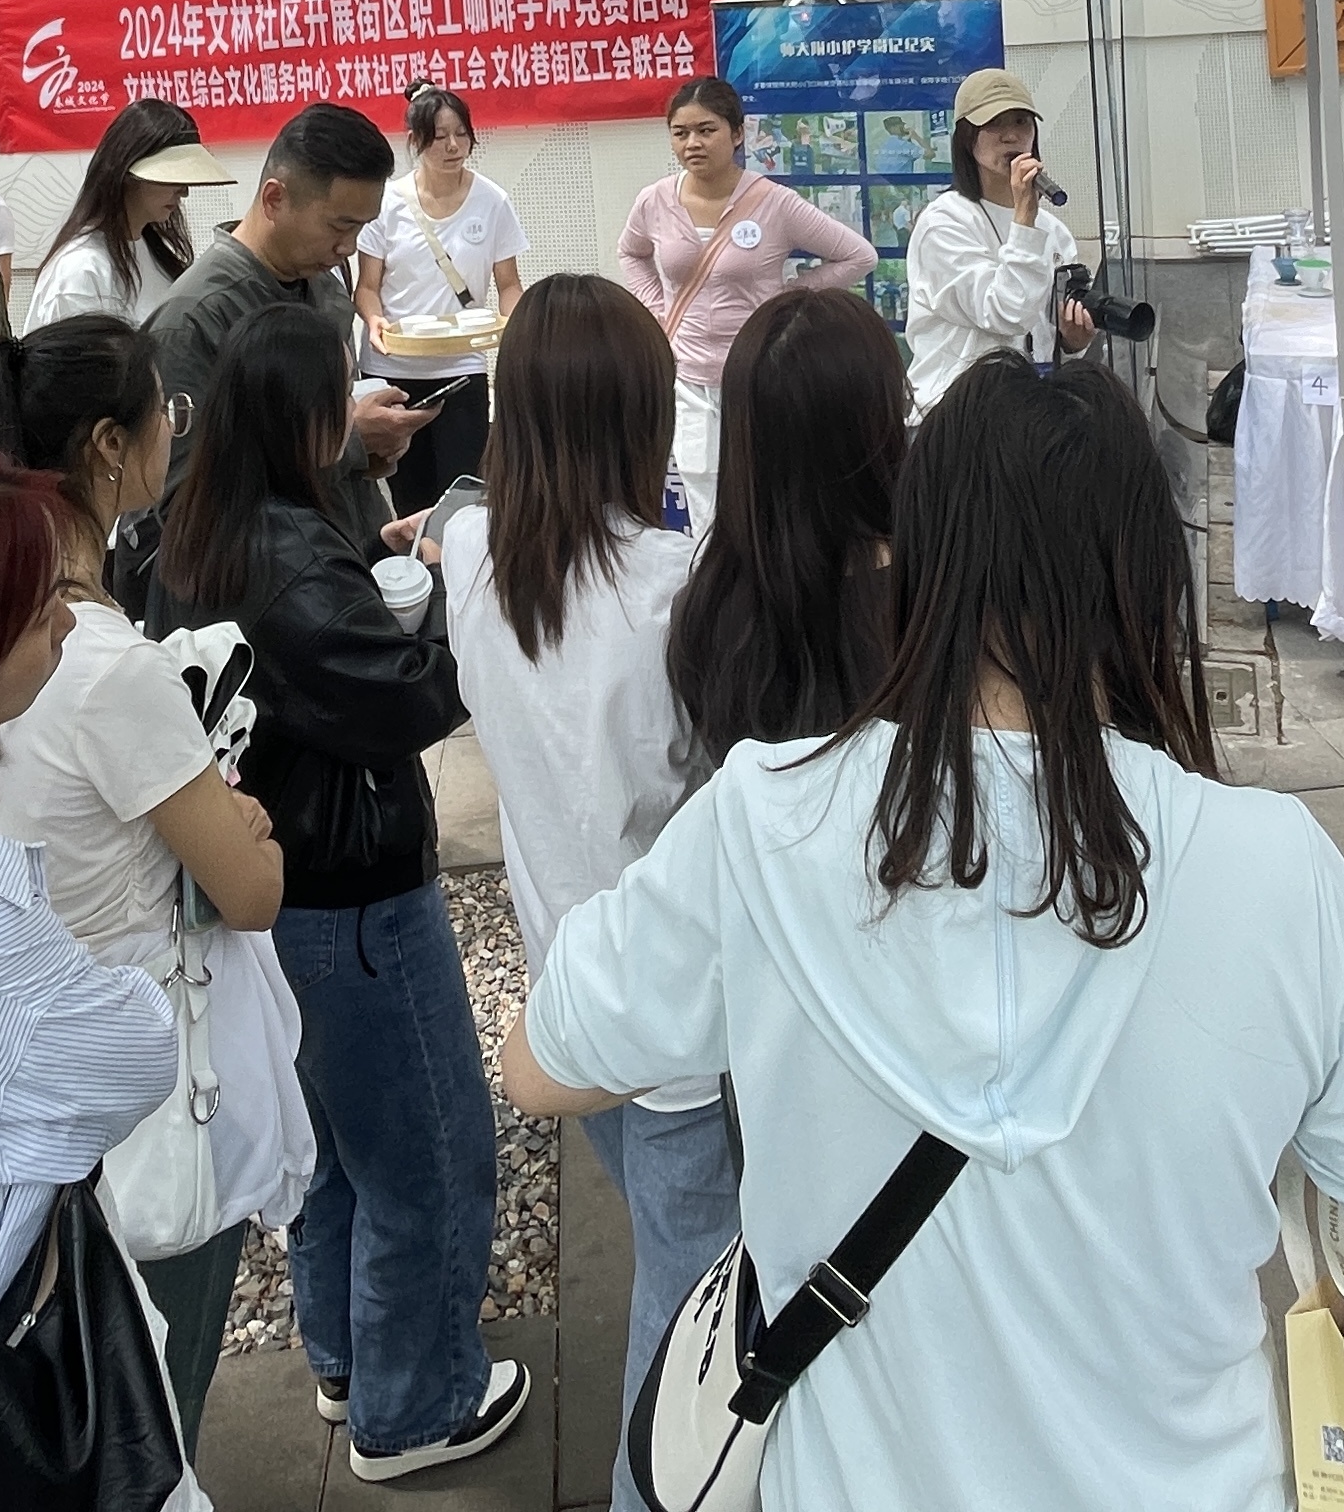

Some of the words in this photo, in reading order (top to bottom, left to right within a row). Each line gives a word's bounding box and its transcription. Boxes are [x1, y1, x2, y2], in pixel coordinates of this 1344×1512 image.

[123, 58, 332, 109] 文林社区综合文化服务中心
[490, 30, 695, 89] 文化巷街区工会联合会
[77, 79, 105, 94] 2024
[1311, 375, 1328, 396] 4
